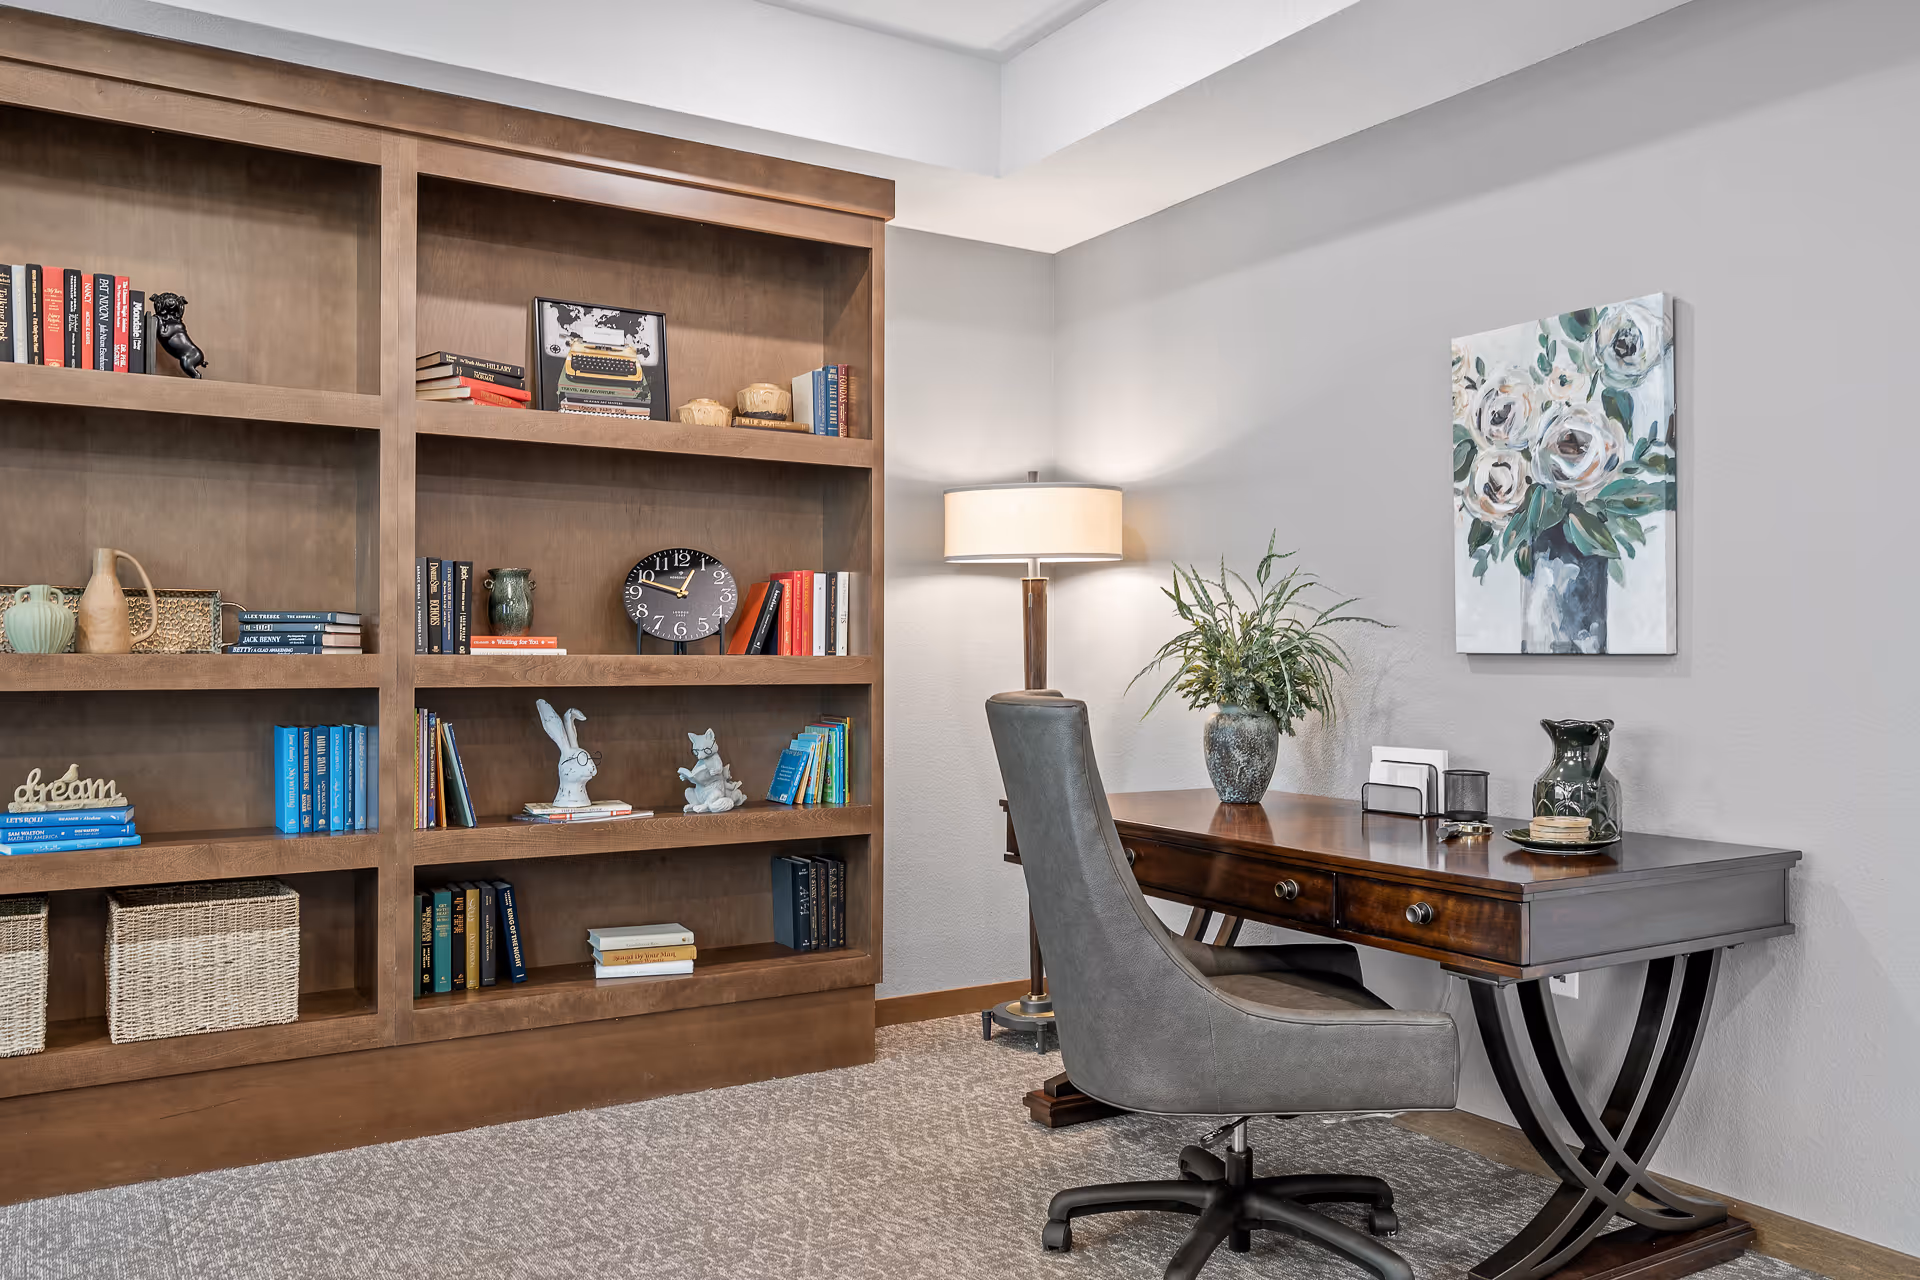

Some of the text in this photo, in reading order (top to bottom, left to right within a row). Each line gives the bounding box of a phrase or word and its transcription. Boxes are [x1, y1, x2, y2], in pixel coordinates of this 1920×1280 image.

[84, 282, 92, 304] NANCY
[99, 278, 109, 321] PAT NIXON
[132, 300, 143, 337] Mondale
[0, 321, 9, 342] Back
[486, 362, 512, 373] HILLARY
[839, 375, 848, 403] FONDAS
[654, 557, 669, 571] 11
[672, 552, 691, 567] 12
[699, 557, 706, 571] 1
[459, 565, 470, 580] jack
[636, 569, 656, 584] 10
[713, 570, 725, 585] 2
[629, 585, 643, 600] 9
[719, 588, 732, 603] 3
[429, 599, 440, 626] ECHOES
[636, 603, 649, 618] 8
[711, 605, 724, 619] 4
[652, 615, 665, 631] 7
[673, 621, 687, 636] 6
[697, 617, 710, 632] 5
[259, 635, 281, 643] BENNY
[496, 639, 518, 647] Waiting
[14, 767, 123, 803] dream
[286, 767, 296, 808] Skywriting
[811, 868, 817, 879] MY
[506, 907, 522, 967] KING OF THE NIGHT
[614, 954, 634, 962] Stand
